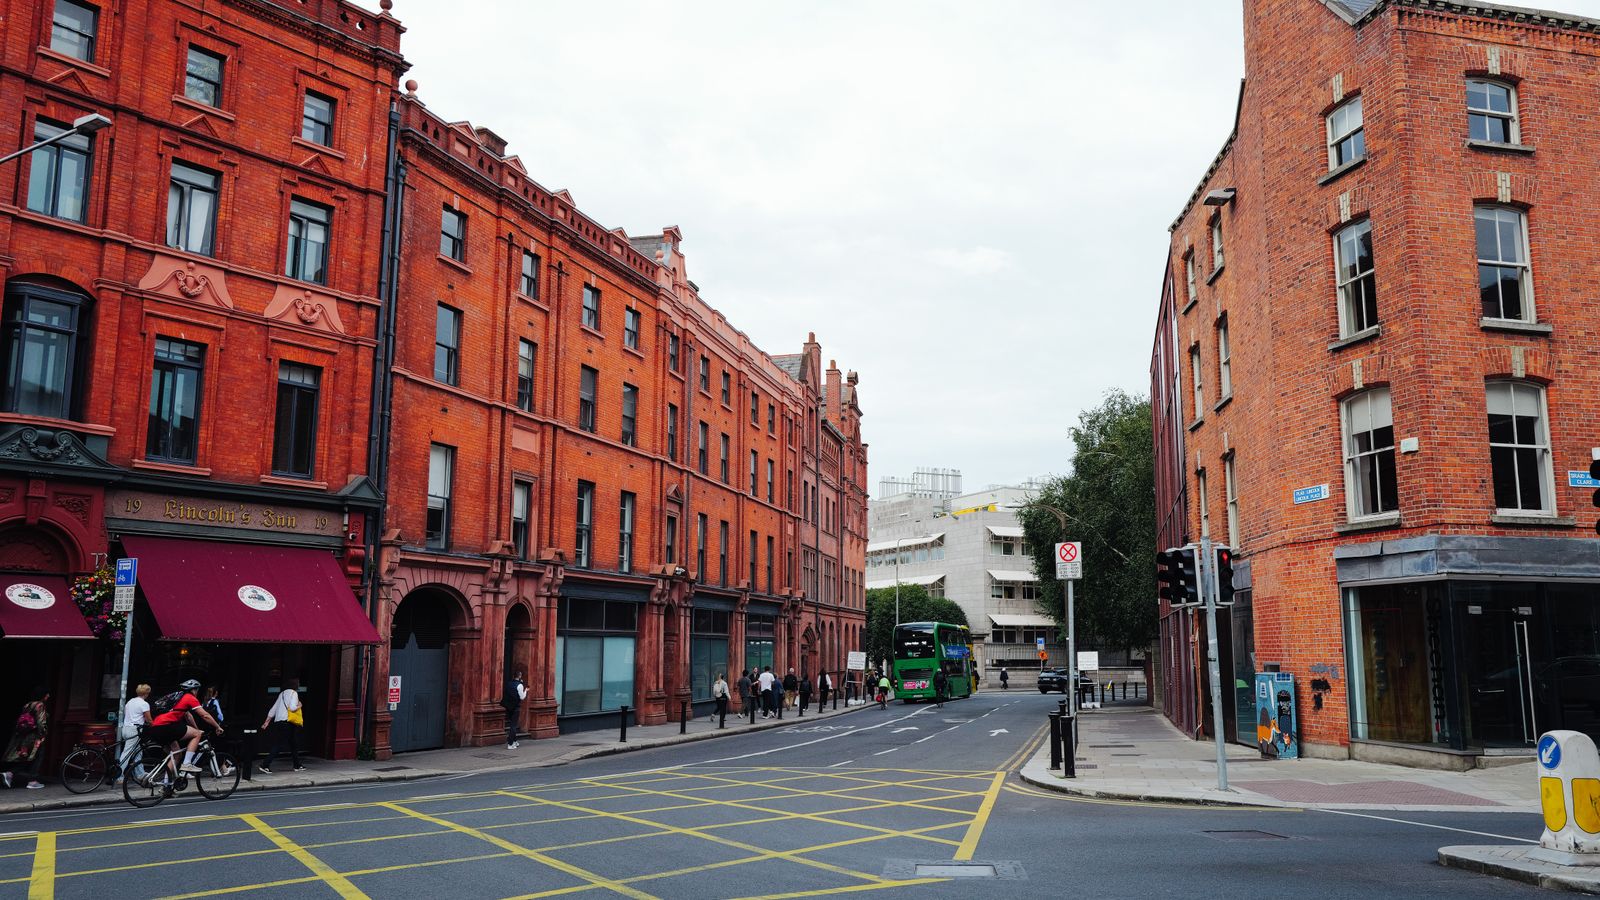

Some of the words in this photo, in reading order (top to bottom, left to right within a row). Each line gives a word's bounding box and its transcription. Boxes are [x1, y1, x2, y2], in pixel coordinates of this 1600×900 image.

[125, 499, 142, 513] 19
[164, 499, 251, 524] Lincoln's
[262, 508, 297, 529] Inn
[314, 516, 328, 530] 19
